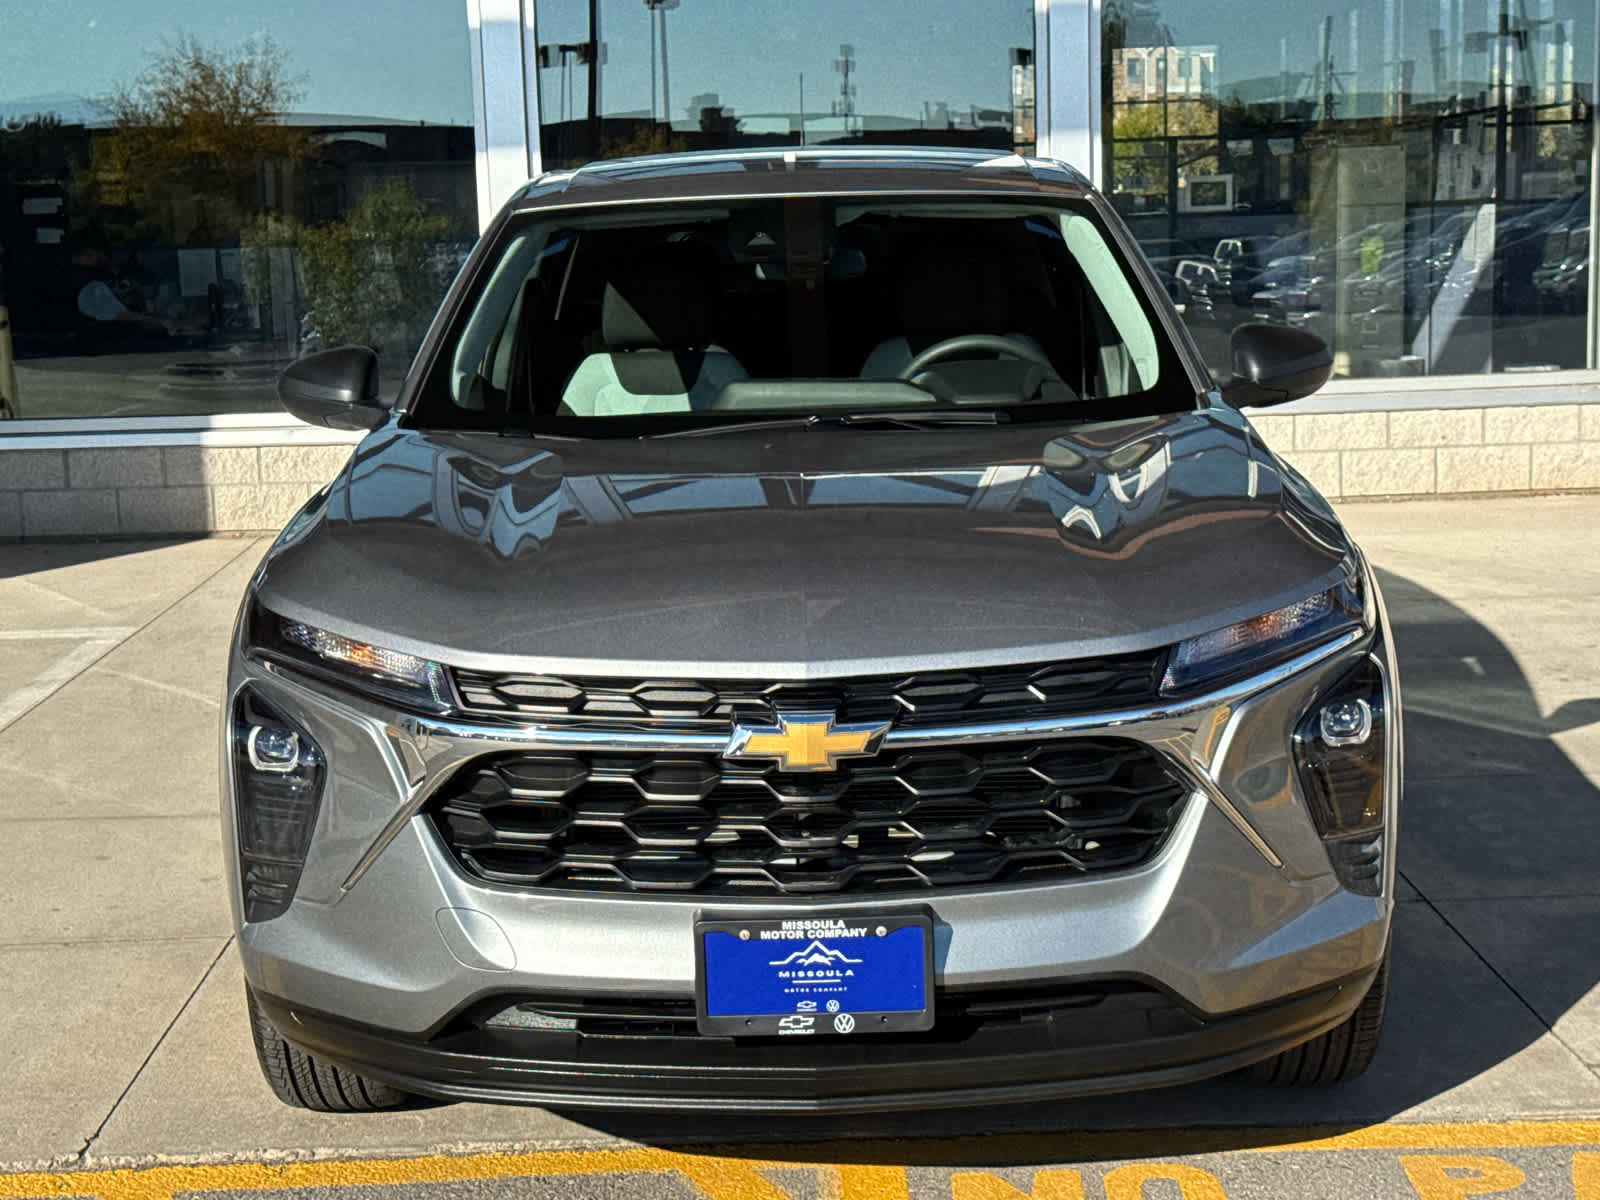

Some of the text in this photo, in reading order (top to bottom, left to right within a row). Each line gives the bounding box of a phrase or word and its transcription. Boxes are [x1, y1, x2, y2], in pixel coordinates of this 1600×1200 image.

[782, 919, 846, 930] MISSOULA
[760, 927, 868, 940] MOTOR COMPANY
[778, 969, 854, 978] MISSOULA
